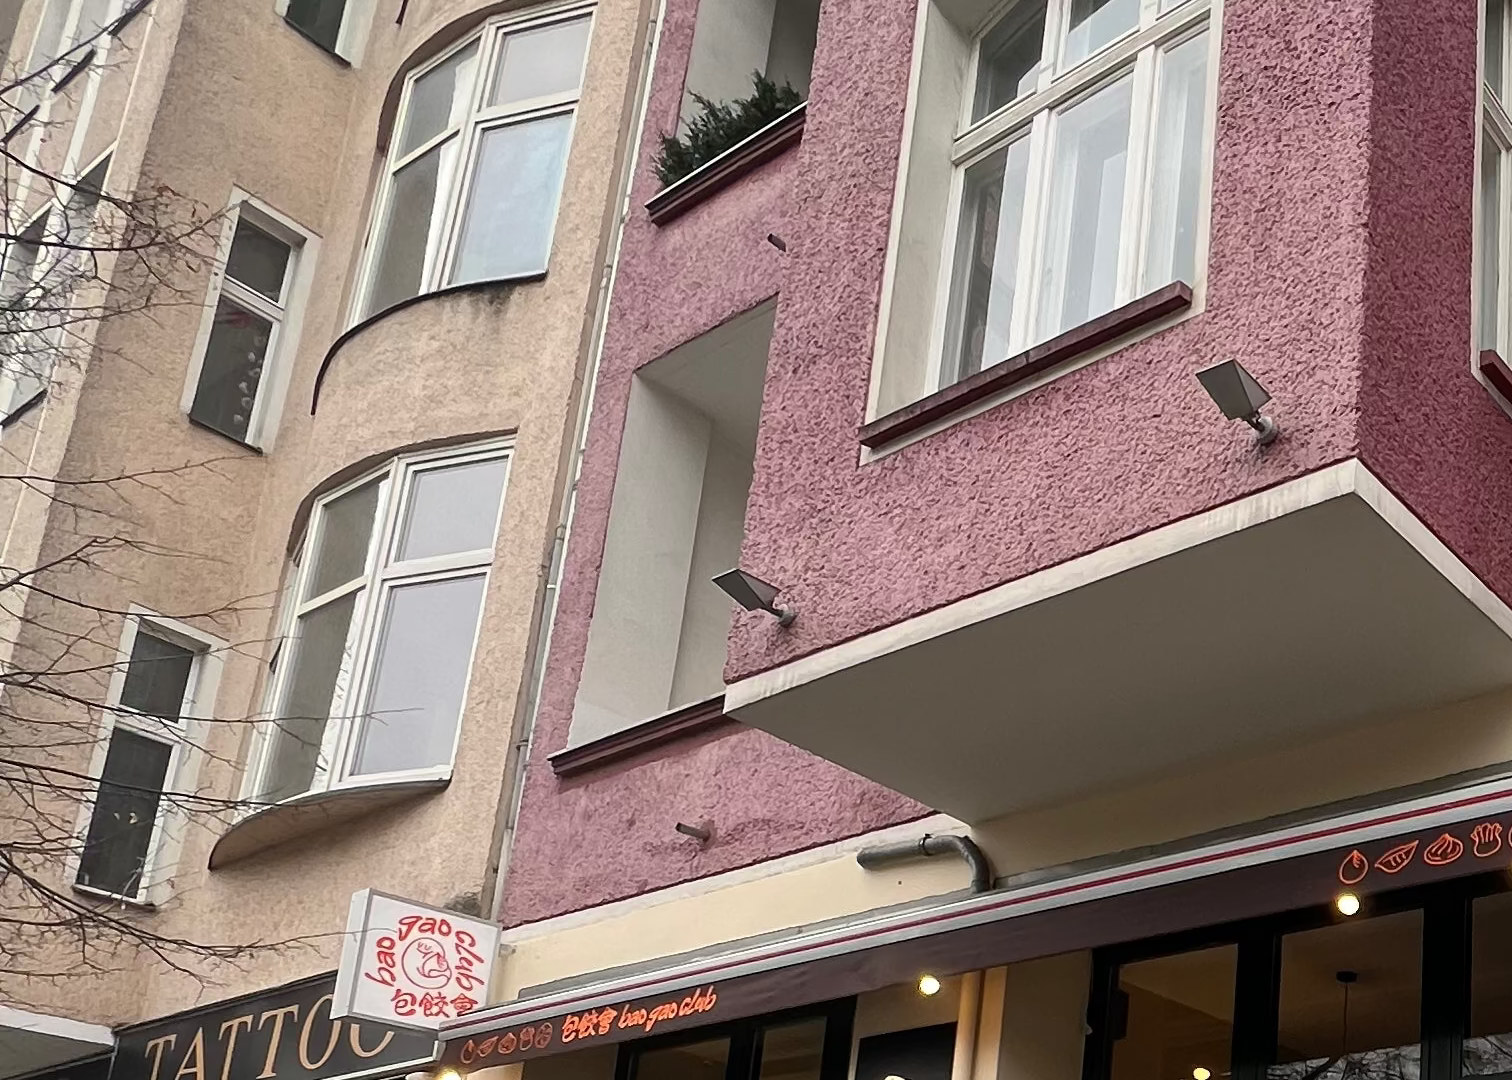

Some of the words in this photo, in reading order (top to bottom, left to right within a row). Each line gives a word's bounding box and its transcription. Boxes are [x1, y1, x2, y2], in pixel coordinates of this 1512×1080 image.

[364, 936, 397, 987] bao
[398, 915, 452, 941] gao
[454, 930, 485, 992] club
[617, 1003, 648, 1029] bao
[644, 1002, 678, 1032] gao
[678, 985, 717, 1017] club
